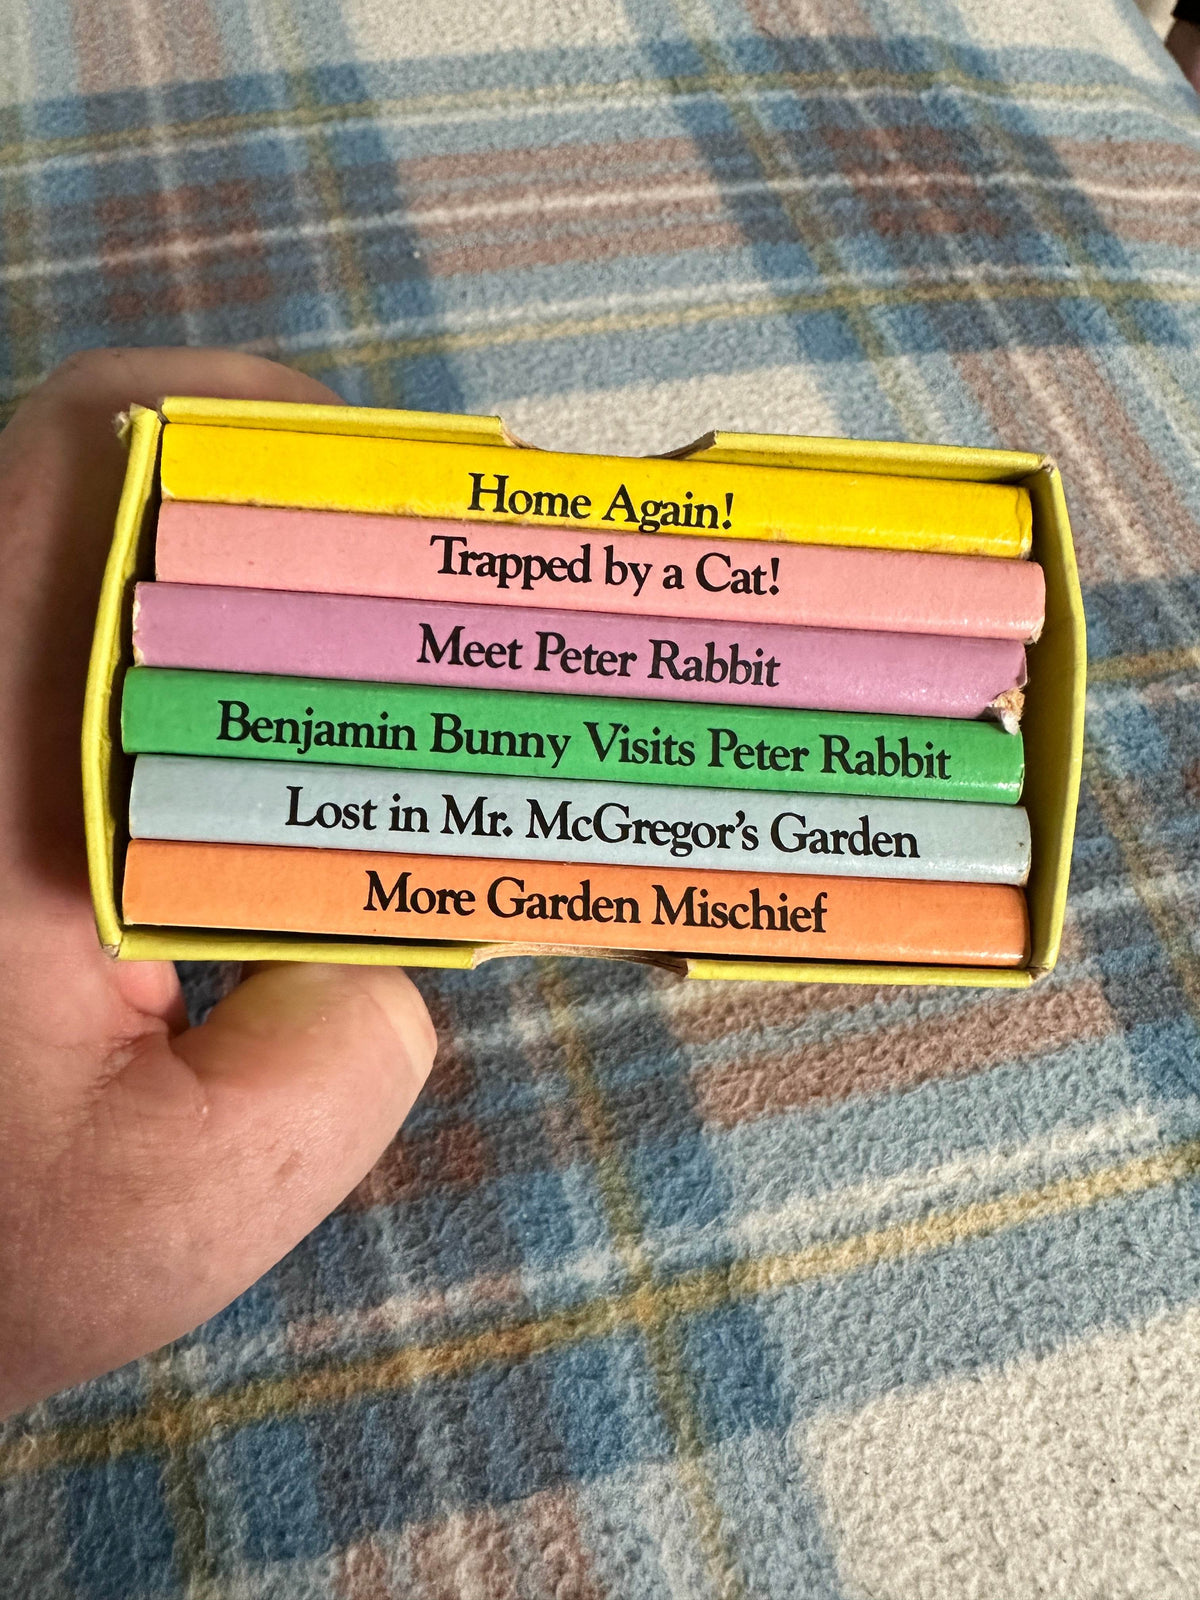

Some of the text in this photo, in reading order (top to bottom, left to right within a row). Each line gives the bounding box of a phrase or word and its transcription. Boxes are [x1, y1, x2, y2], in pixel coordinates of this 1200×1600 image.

[468, 473, 734, 535] Home Again!
[430, 535, 780, 597] Trapped by a Cat!
[417, 623, 780, 687] Meet Peter Rabbit
[216, 700, 951, 779] Benjamin Bunny Visits Peter Rabbit
[285, 786, 920, 858] Lost in Mr. McGregor’s Garden
[364, 871, 828, 932] More Garden Mischief
